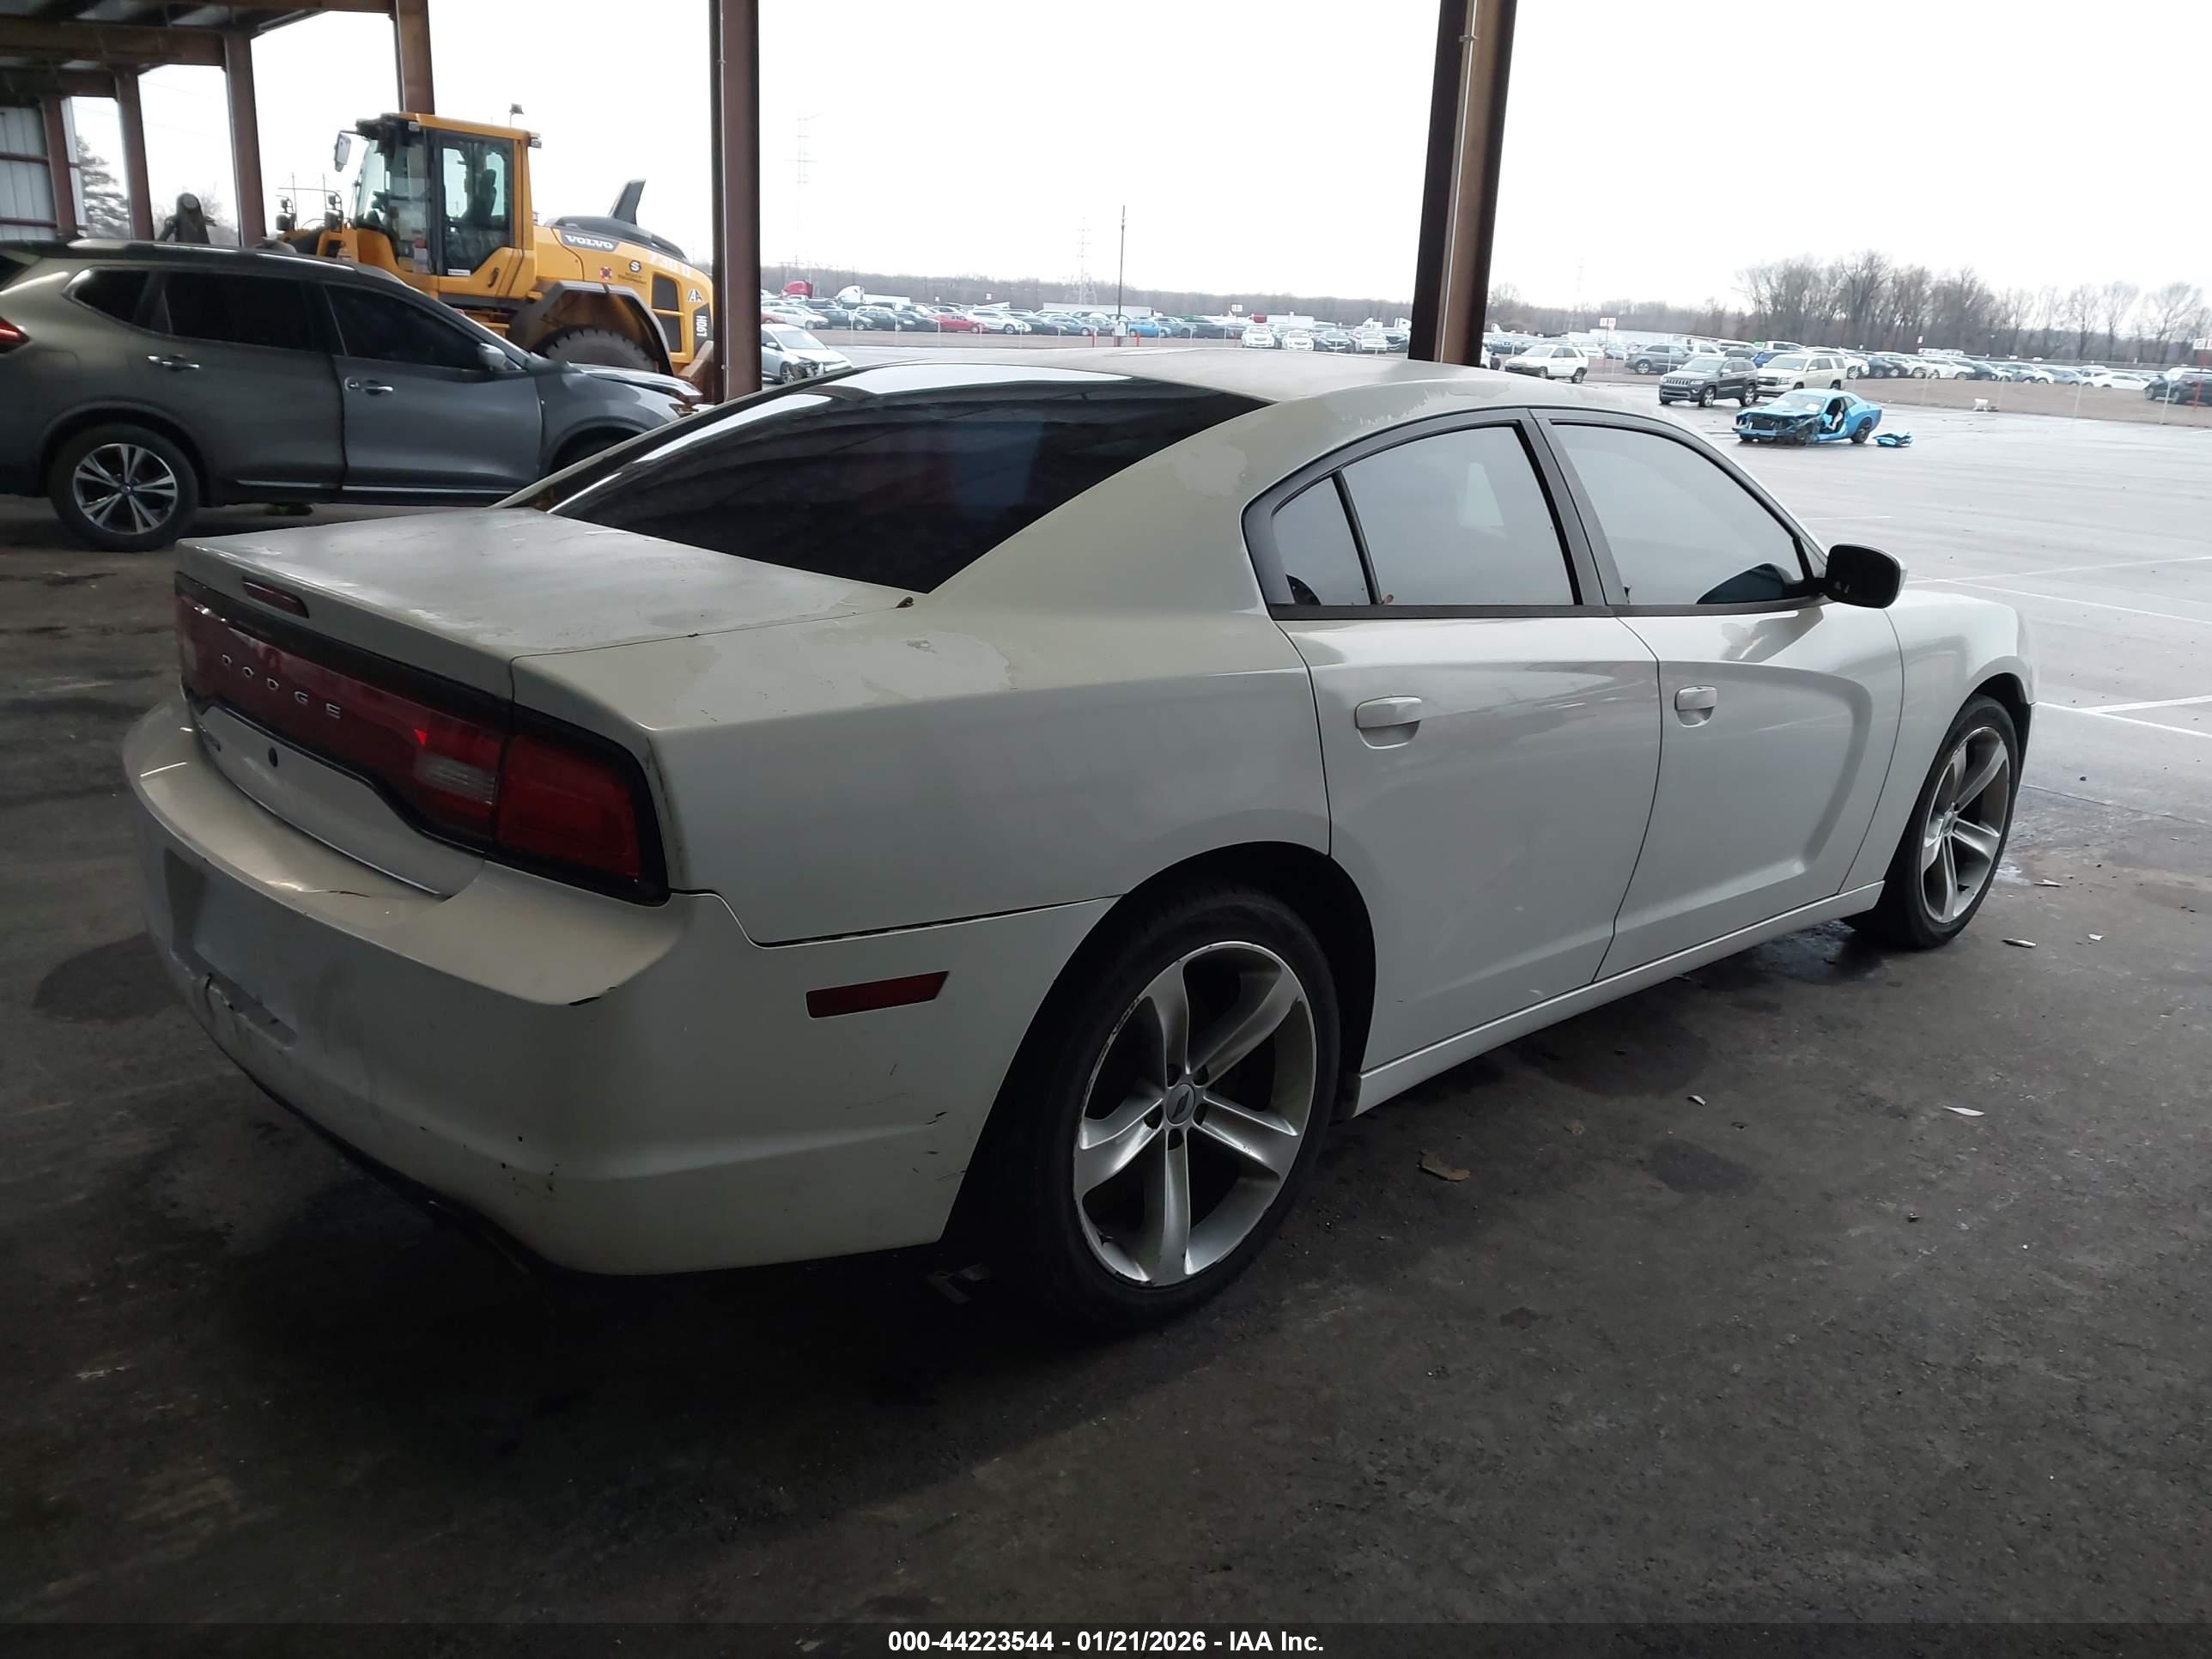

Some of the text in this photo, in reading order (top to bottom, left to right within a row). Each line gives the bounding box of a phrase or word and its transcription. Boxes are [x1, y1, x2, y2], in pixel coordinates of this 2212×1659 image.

[565, 234, 614, 250] VOLVO
[696, 315, 708, 337] L90H
[222, 654, 341, 719] DODGE
